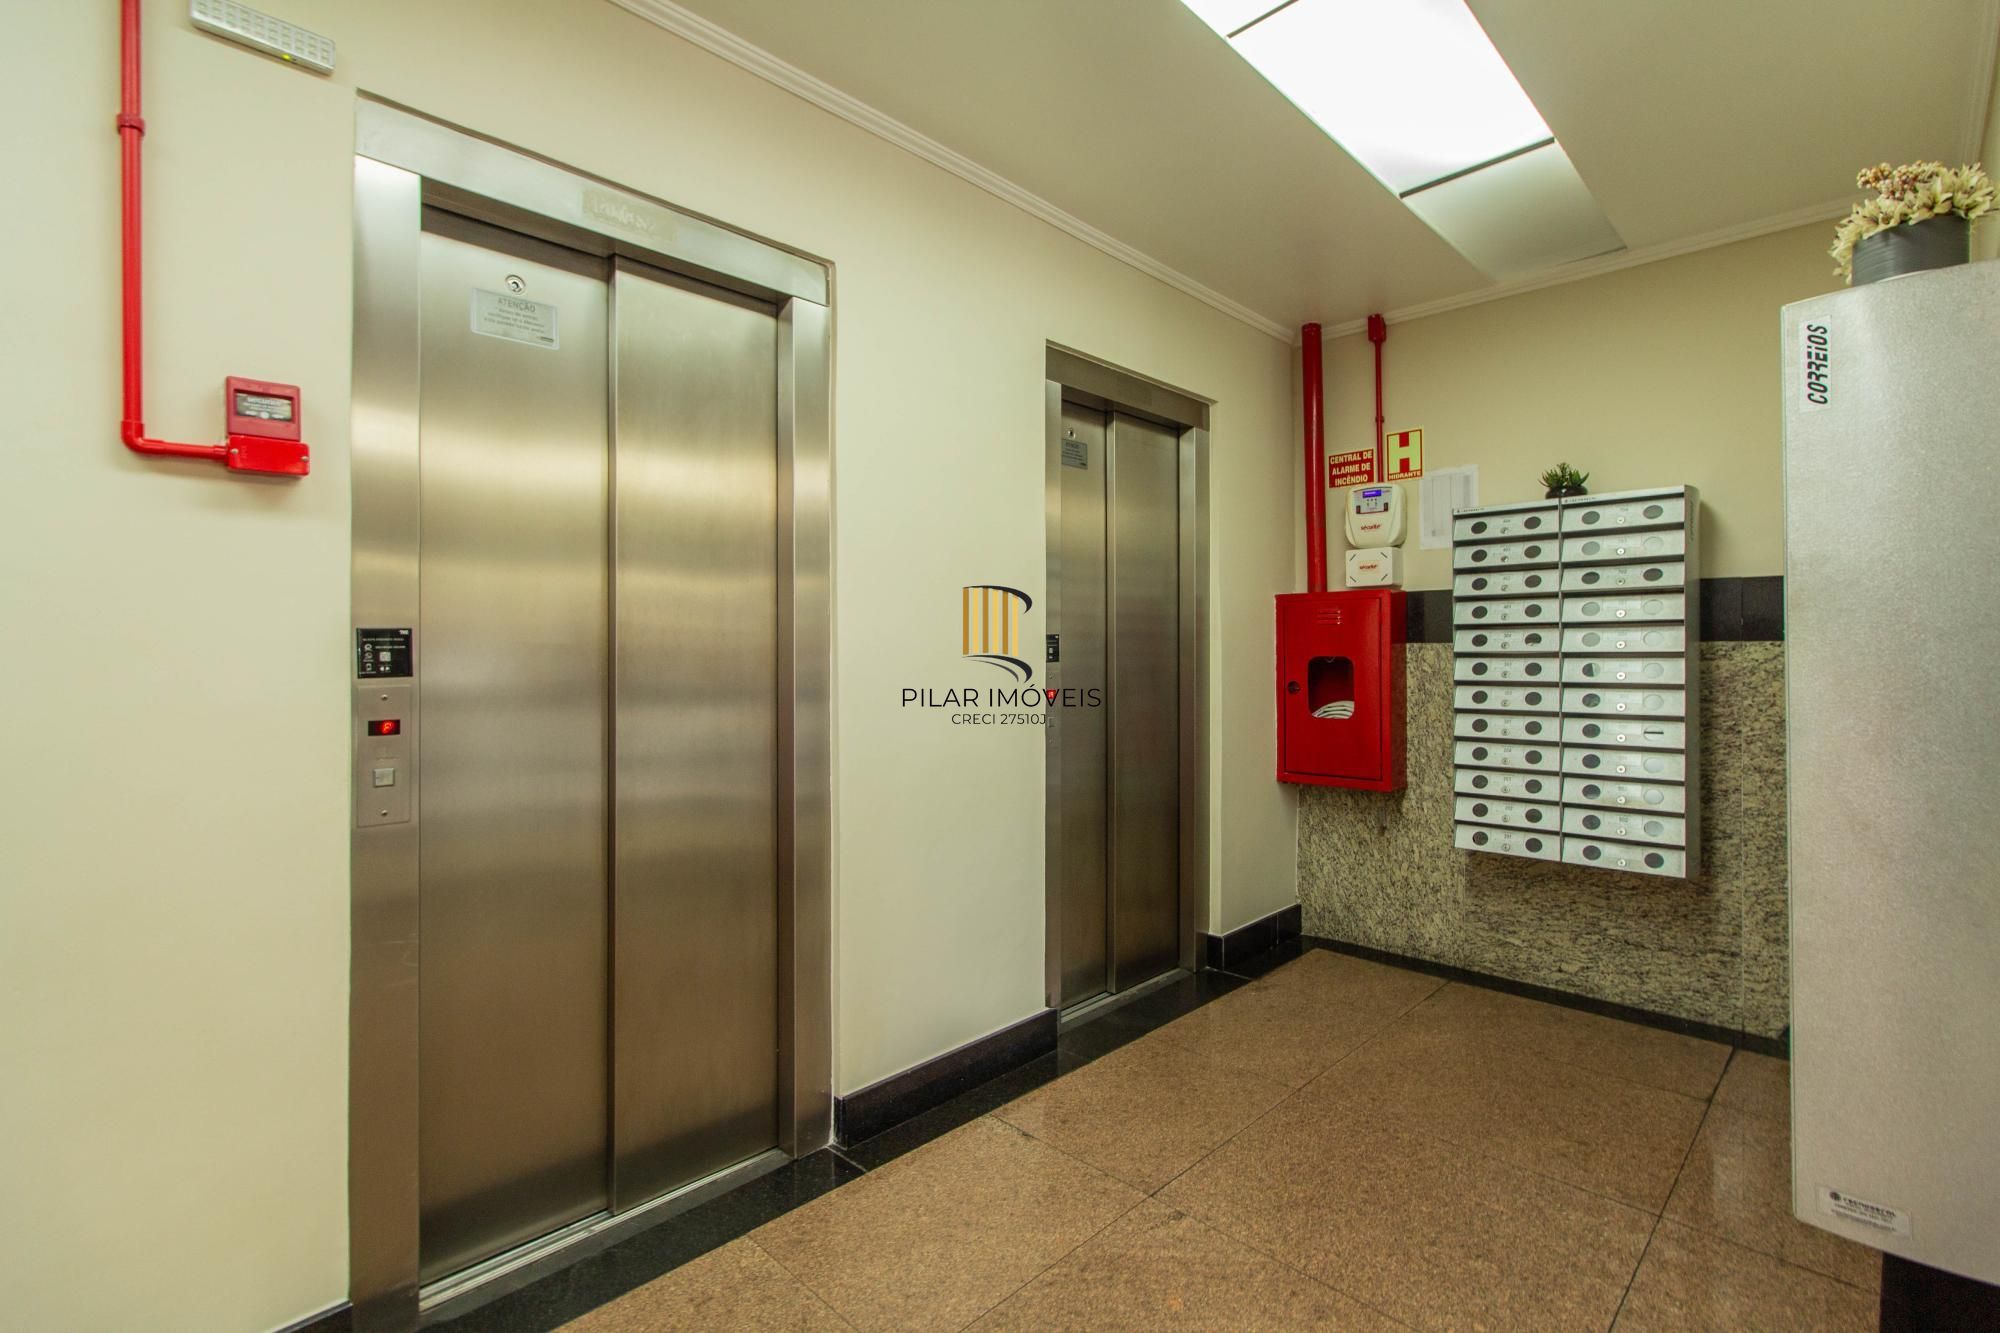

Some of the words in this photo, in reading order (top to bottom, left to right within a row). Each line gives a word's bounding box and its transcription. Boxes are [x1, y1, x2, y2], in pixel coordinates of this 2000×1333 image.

[497, 297, 536, 313] ATENÇÃO
[1330, 452, 1362, 464] CENTRAL
[1362, 450, 1373, 460] DE
[1388, 431, 1421, 474] H
[1332, 464, 1360, 475] ALARME
[1361, 462, 1371, 471] DE
[1335, 474, 1368, 486] INCÊNDIO
[1388, 471, 1421, 480] HIDRANTE
